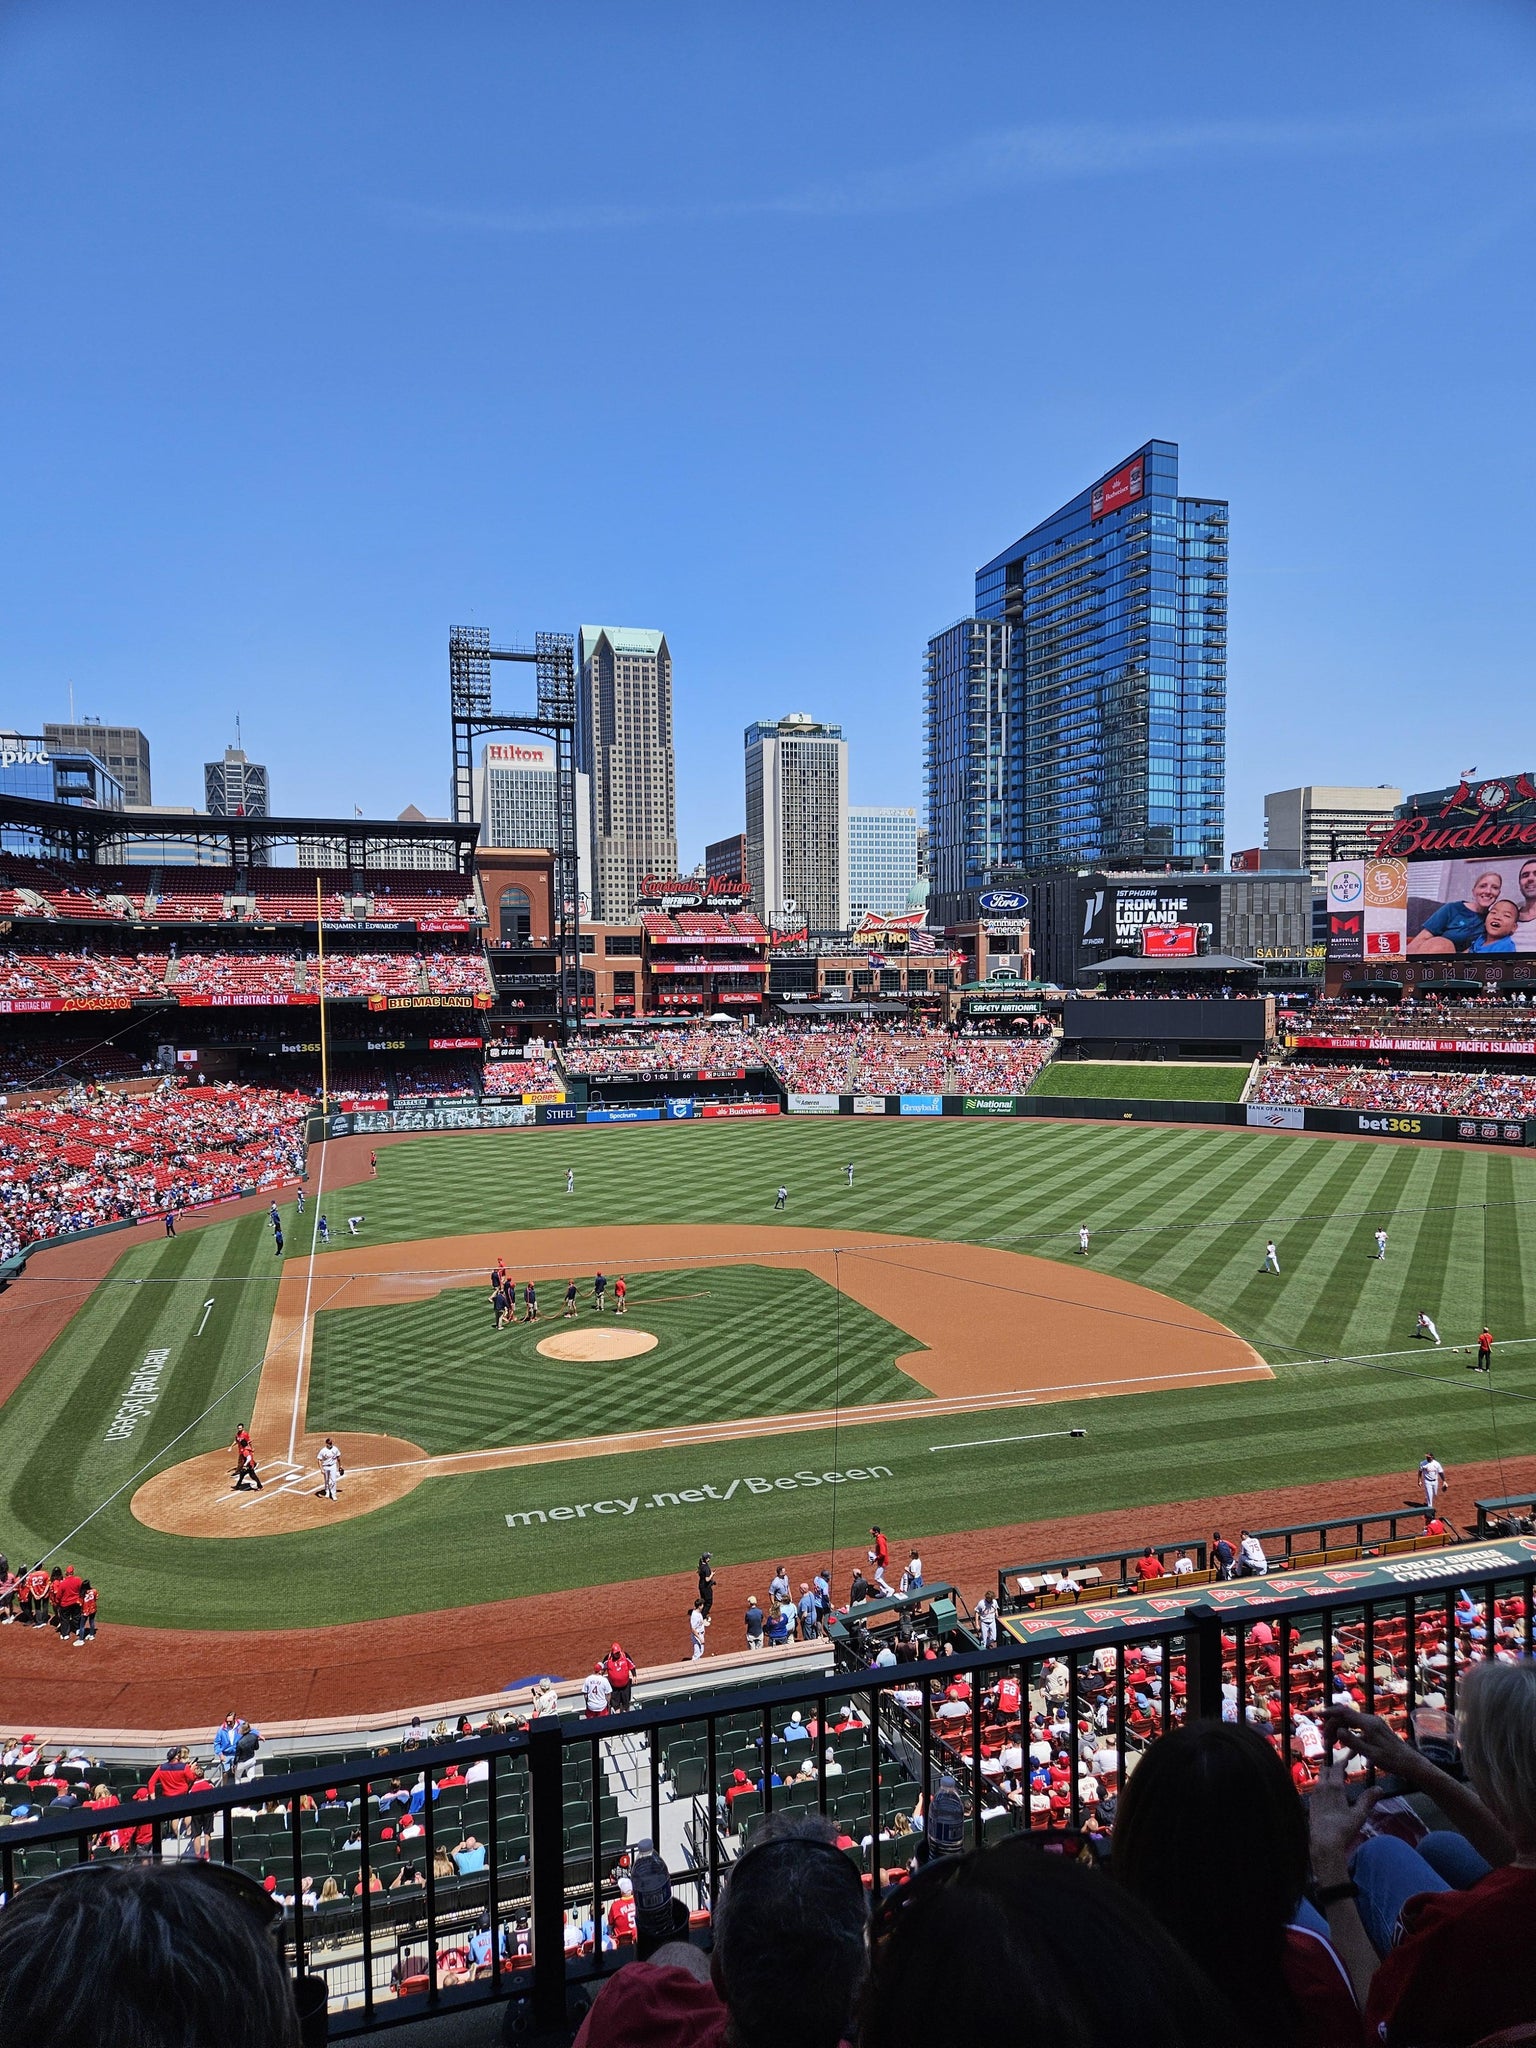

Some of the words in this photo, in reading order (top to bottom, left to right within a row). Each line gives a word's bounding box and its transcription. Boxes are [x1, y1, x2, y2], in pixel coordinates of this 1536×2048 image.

[490, 745, 544, 761] Hilton
[0, 750, 49, 768] pwc
[1376, 858, 1400, 868] LOUIS
[641, 873, 699, 896] Cardinals
[701, 874, 752, 896] Nation
[990, 894, 1019, 907] Ford
[1116, 898, 1157, 911] FROM
[1160, 898, 1188, 910] THE
[1116, 911, 1143, 923] LOU
[1146, 911, 1178, 923] AND
[859, 918, 922, 931] Budweiser
[983, 919, 1027, 928] Community
[853, 933, 885, 943] BREW
[1257, 947, 1291, 958] SALT
[1485, 968, 1502, 979] 20
[1513, 967, 1530, 979] 23
[15, 1001, 40, 1010] HERITAGE
[41, 1001, 52, 1009] DAY
[211, 995, 231, 1005] AAPI
[233, 995, 271, 1004] HERITAGE
[273, 995, 289, 1004] DAY
[388, 998, 411, 1009] BIG
[413, 997, 440, 1007] MAC
[442, 996, 472, 1007] LAND
[973, 1004, 1000, 1012] SAFETY
[281, 1043, 321, 1052] bet365
[367, 1041, 405, 1050] bet365
[1331, 1039, 1358, 1047] WELCOME
[1359, 1039, 1366, 1047] TO
[1369, 1039, 1393, 1049] ASIAN
[1394, 1040, 1437, 1050] AMERICAN
[1456, 1042, 1490, 1052] PACIFIC
[1491, 1043, 1535, 1054] ISLANDER
[976, 1100, 1013, 1109] National
[546, 1109, 576, 1119] STIFEL
[728, 1105, 766, 1116] Budweiser
[1358, 1116, 1421, 1133] bet365
[504, 1465, 893, 1528] mercy.net/BeSeen
[1378, 1558, 1445, 1574] WORLD
[1444, 1549, 1503, 1563] SERIES
[1393, 1556, 1519, 1583] CHAMPIONS
[1215, 1590, 1240, 1600] 1964
[1154, 1600, 1180, 1608] 1944
[1091, 1610, 1115, 1619] 1934
[1026, 1621, 1053, 1630] 1926
[1103, 1655, 1116, 1668] 20
[592, 1685, 598, 1695] 4
[1003, 1683, 1016, 1696] 28
[1303, 1733, 1317, 1746] 29
